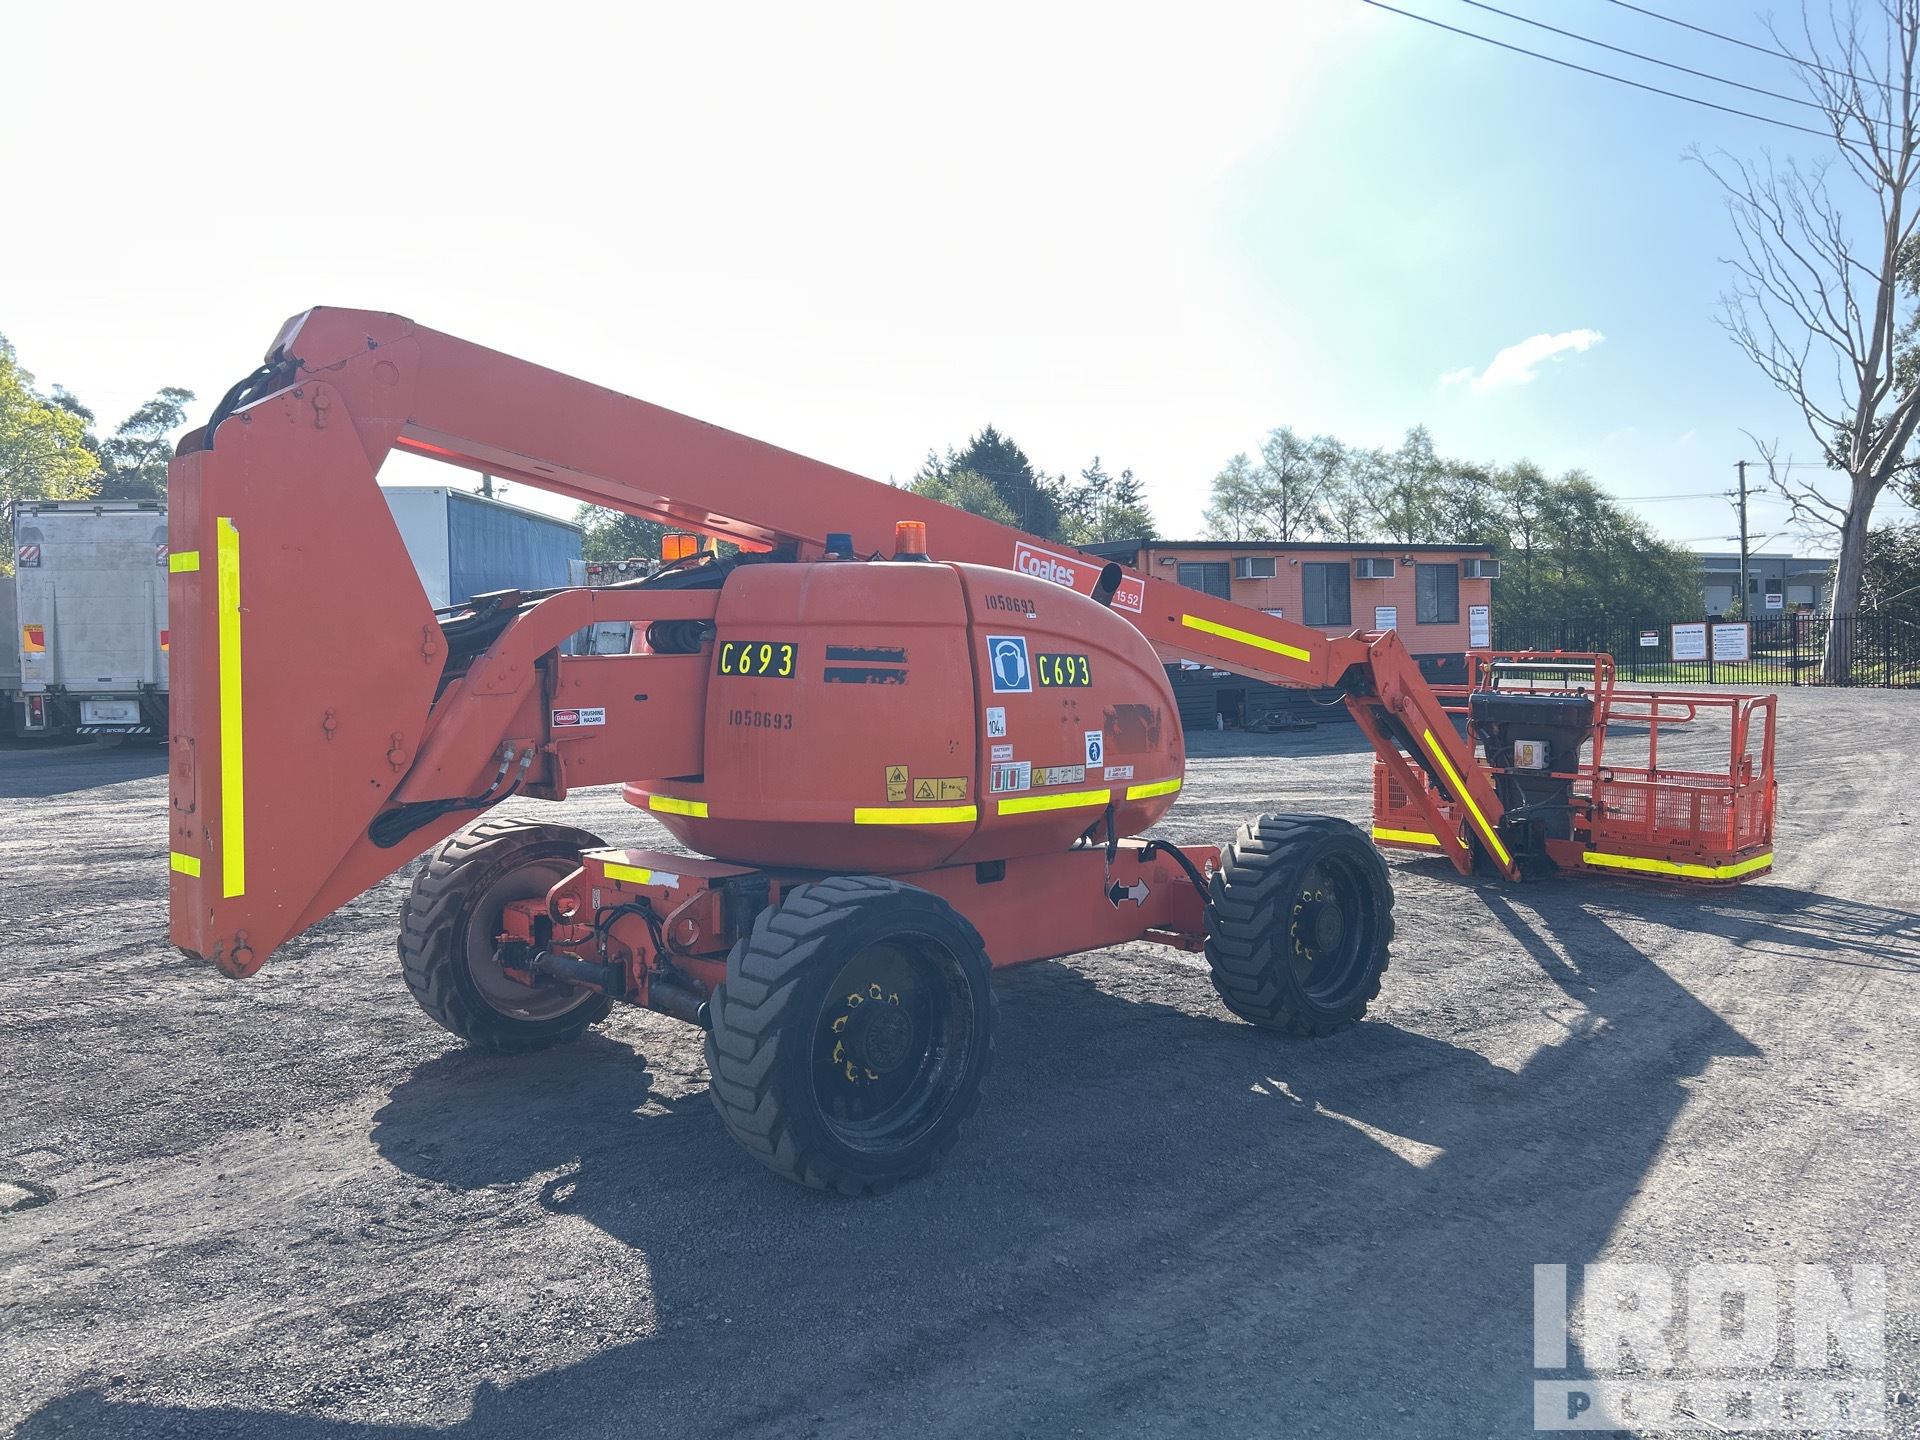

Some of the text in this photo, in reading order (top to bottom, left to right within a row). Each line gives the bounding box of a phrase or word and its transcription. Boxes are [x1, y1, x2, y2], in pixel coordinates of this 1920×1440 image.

[1018, 551, 1075, 587] Coates
[984, 594, 1036, 614] 1058693
[1116, 590, 1139, 606] 15 52
[720, 642, 793, 676] C693
[1039, 655, 1090, 685] C693
[580, 709, 604, 717] CRUSHING
[729, 709, 793, 730] 1058693
[989, 720, 1001, 735] 104
